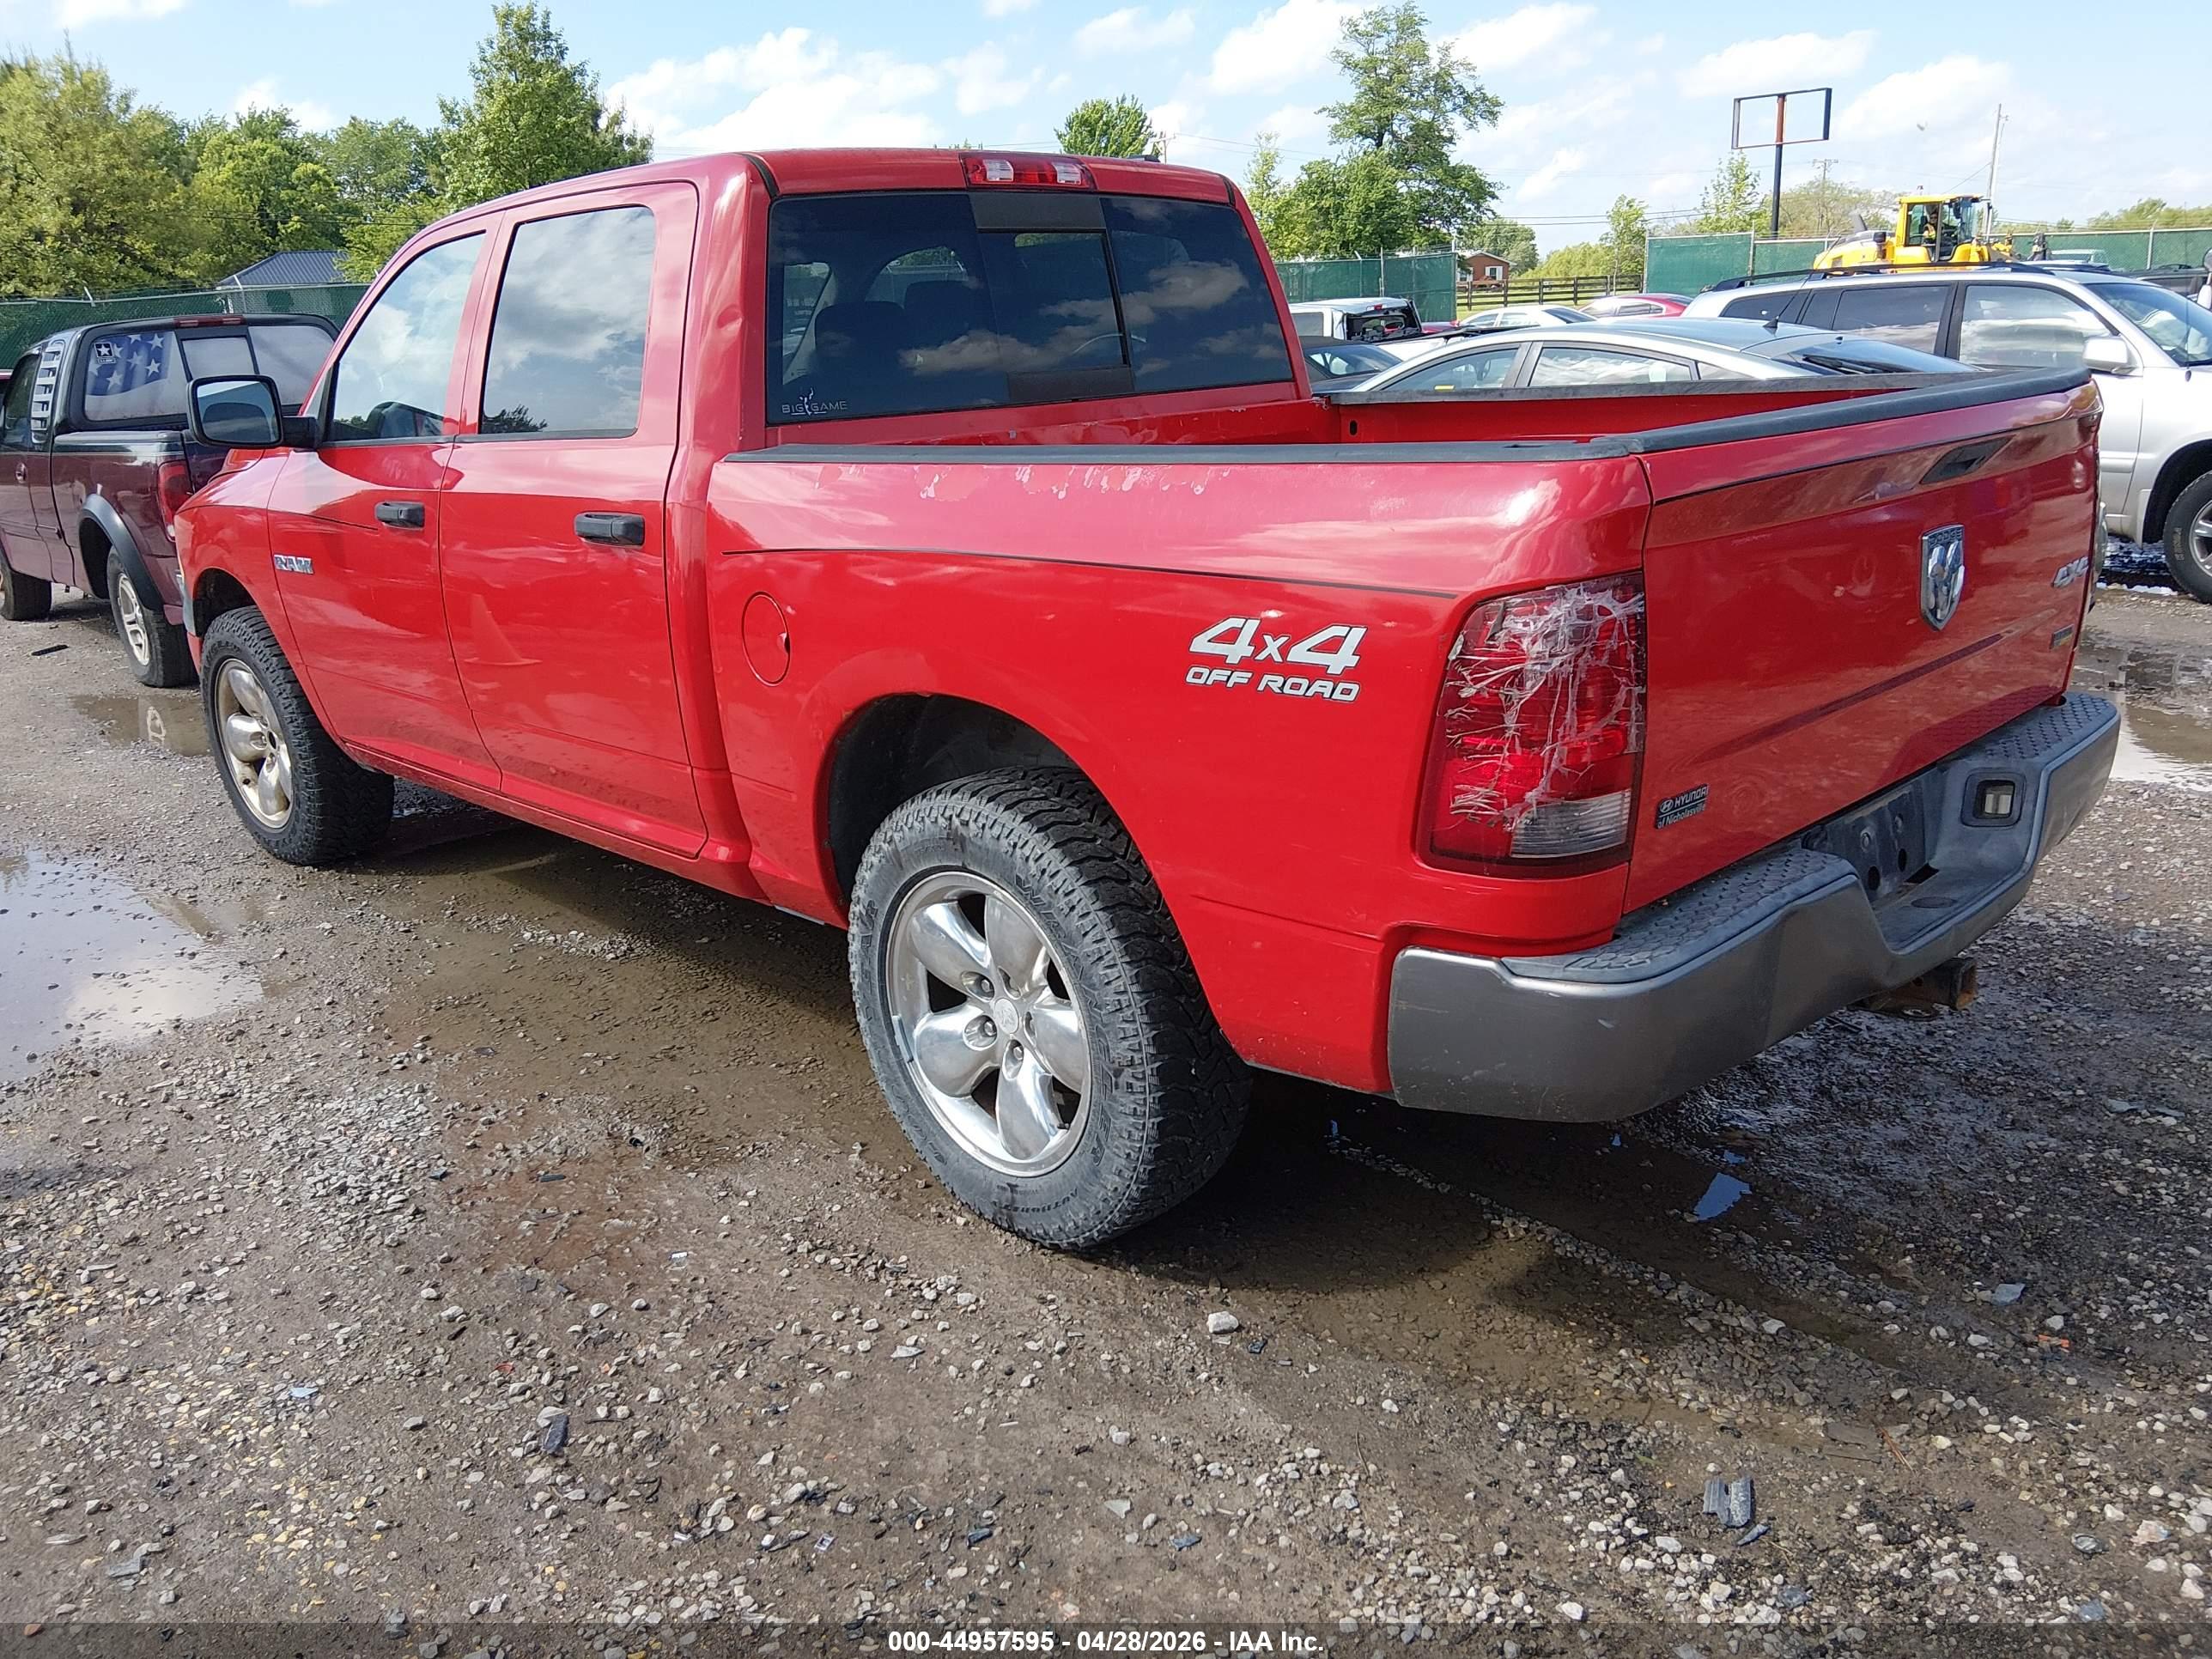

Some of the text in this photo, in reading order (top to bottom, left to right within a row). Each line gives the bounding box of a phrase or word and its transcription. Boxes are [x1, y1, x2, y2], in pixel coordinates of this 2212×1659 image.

[782, 401, 848, 413] BIG GAME
[1929, 529, 1962, 548] DODGE
[1188, 615, 1369, 676] 4x4
[1184, 666, 1361, 702] OFF ROAD
[1674, 785, 1709, 807] HYUNDAI
[1014, 873, 1114, 1167] WRANGLER
